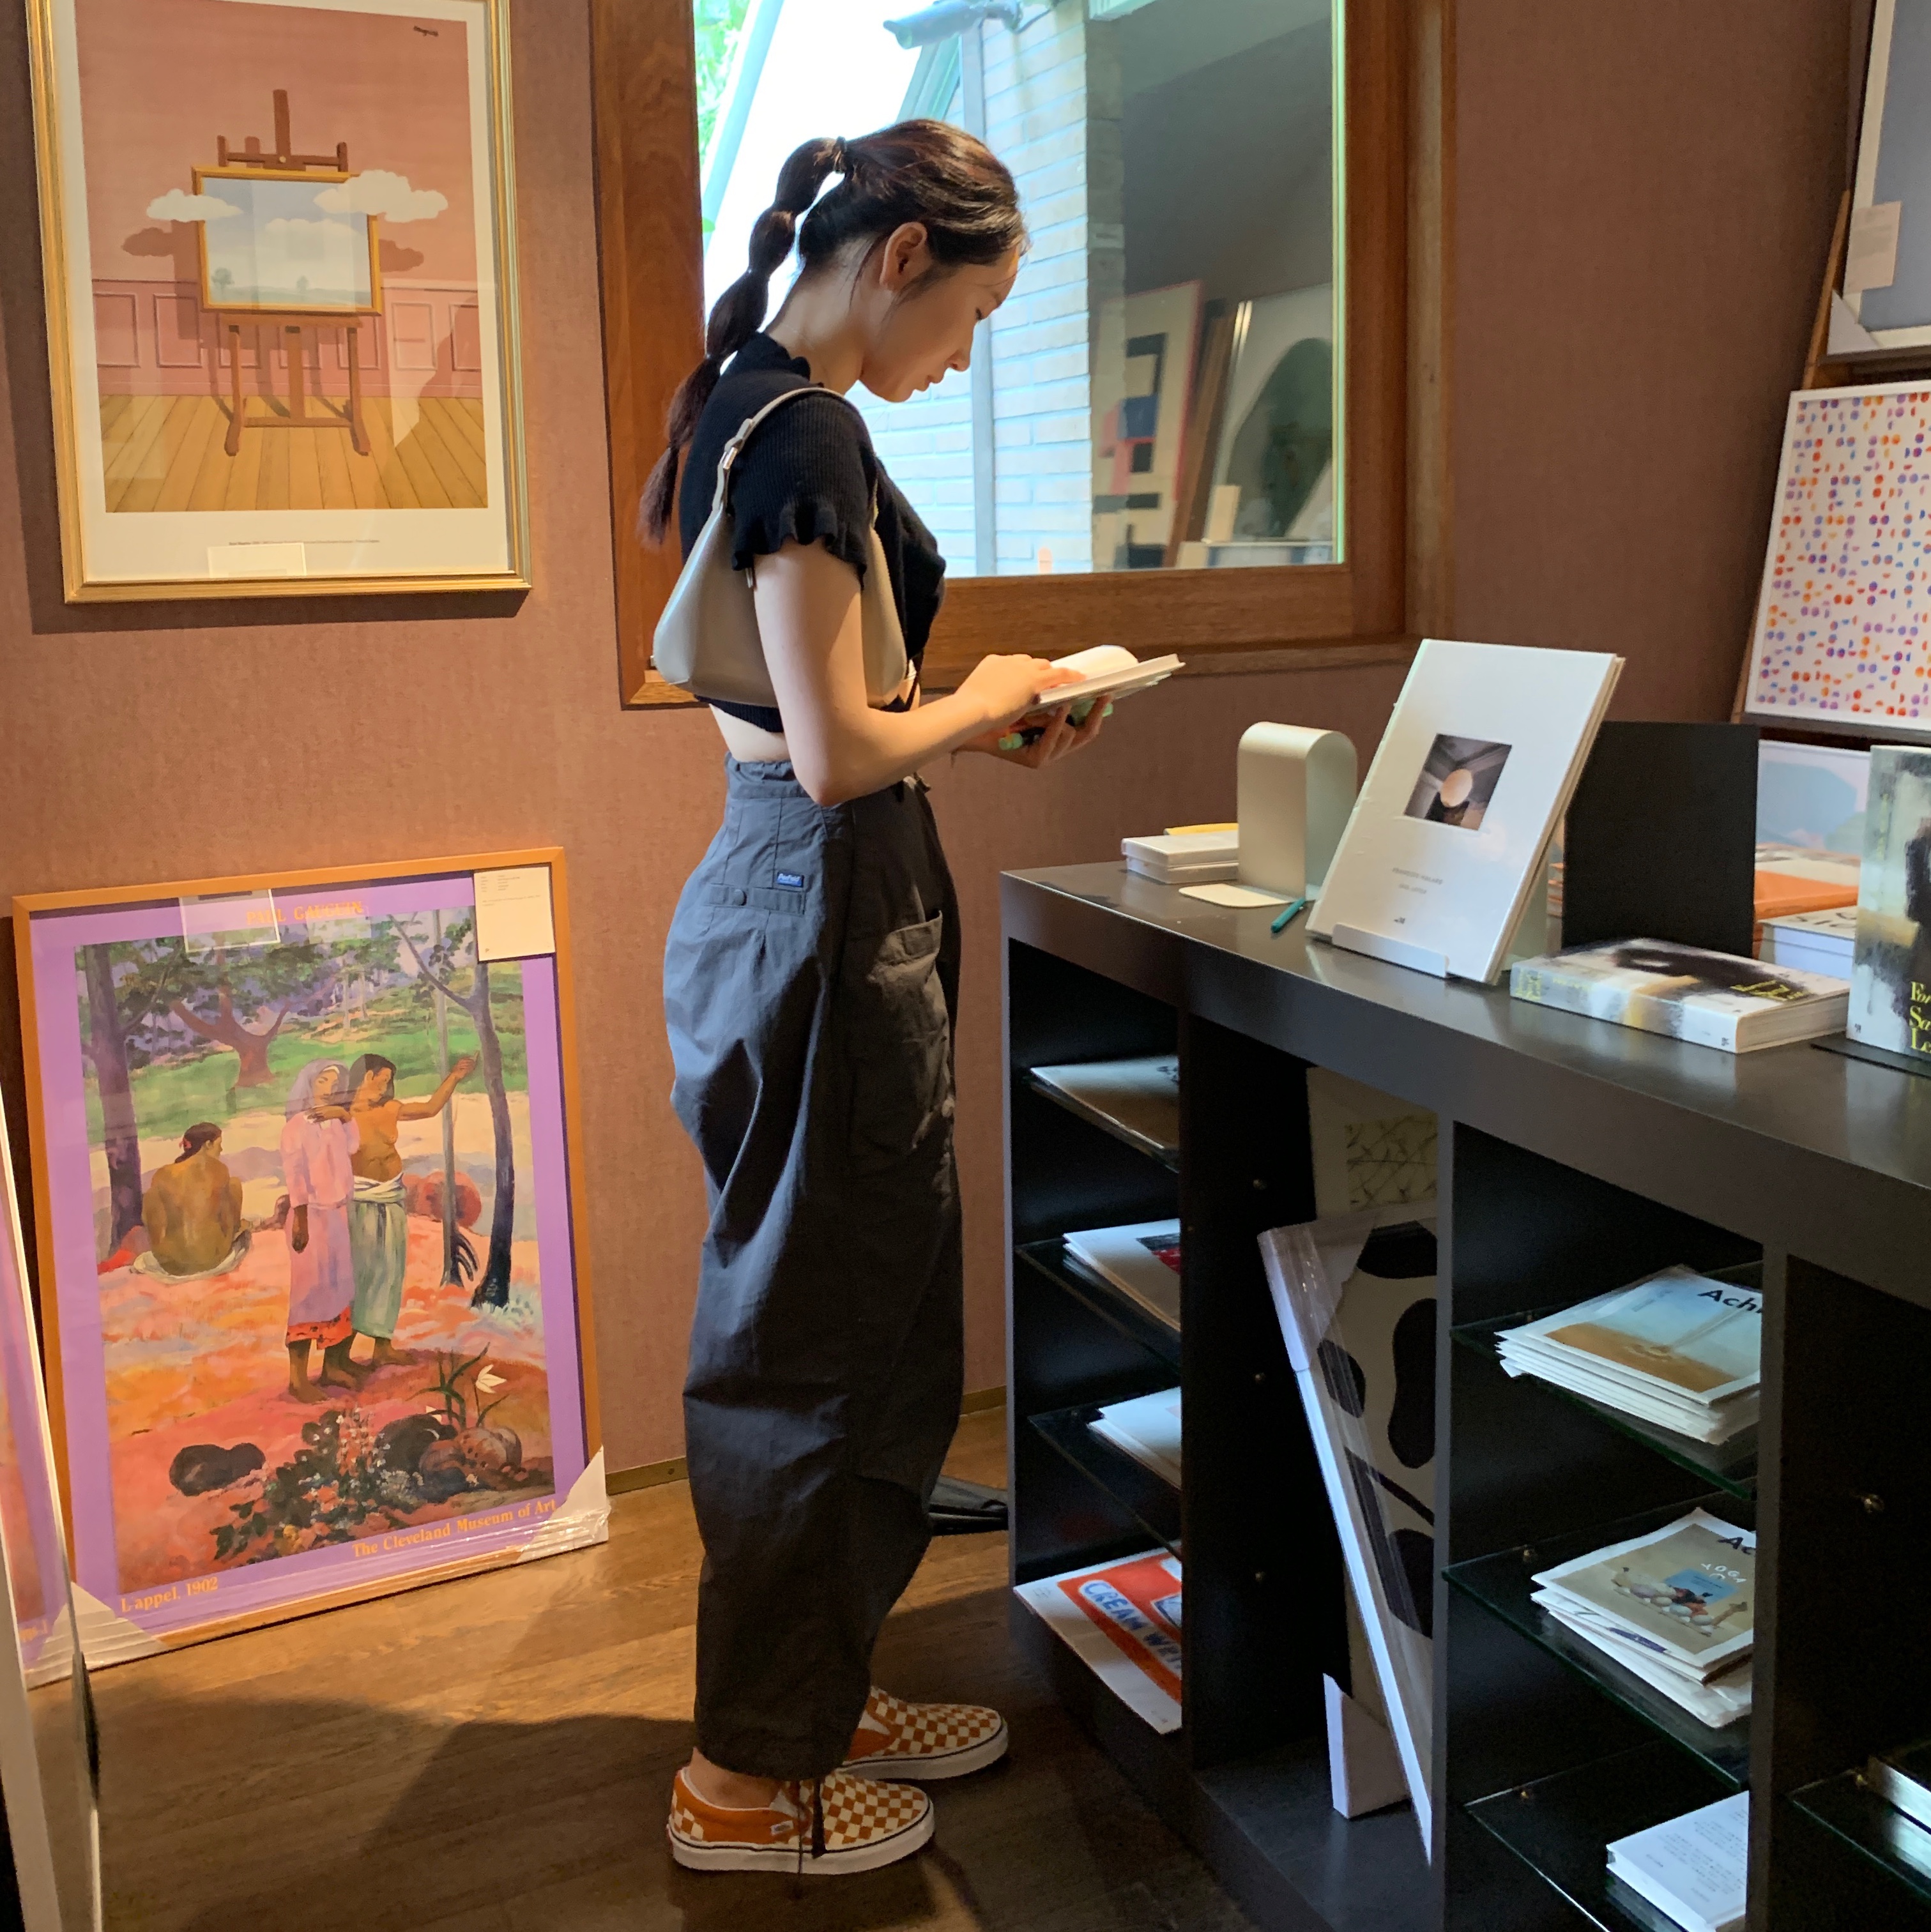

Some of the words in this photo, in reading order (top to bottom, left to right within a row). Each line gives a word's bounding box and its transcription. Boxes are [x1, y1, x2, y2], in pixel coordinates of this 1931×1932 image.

[246, 908, 286, 925] PAUL
[294, 901, 363, 921] GAUGUIN
[1697, 1289, 1762, 1314] Ach
[352, 1541, 378, 1557] The
[383, 1522, 451, 1550] Cleveland
[457, 1510, 514, 1532] Museum
[517, 1502, 531, 1518] of
[535, 1498, 557, 1515] Art
[185, 1576, 219, 1597] 1902
[1084, 1581, 1150, 1631] CREAM
